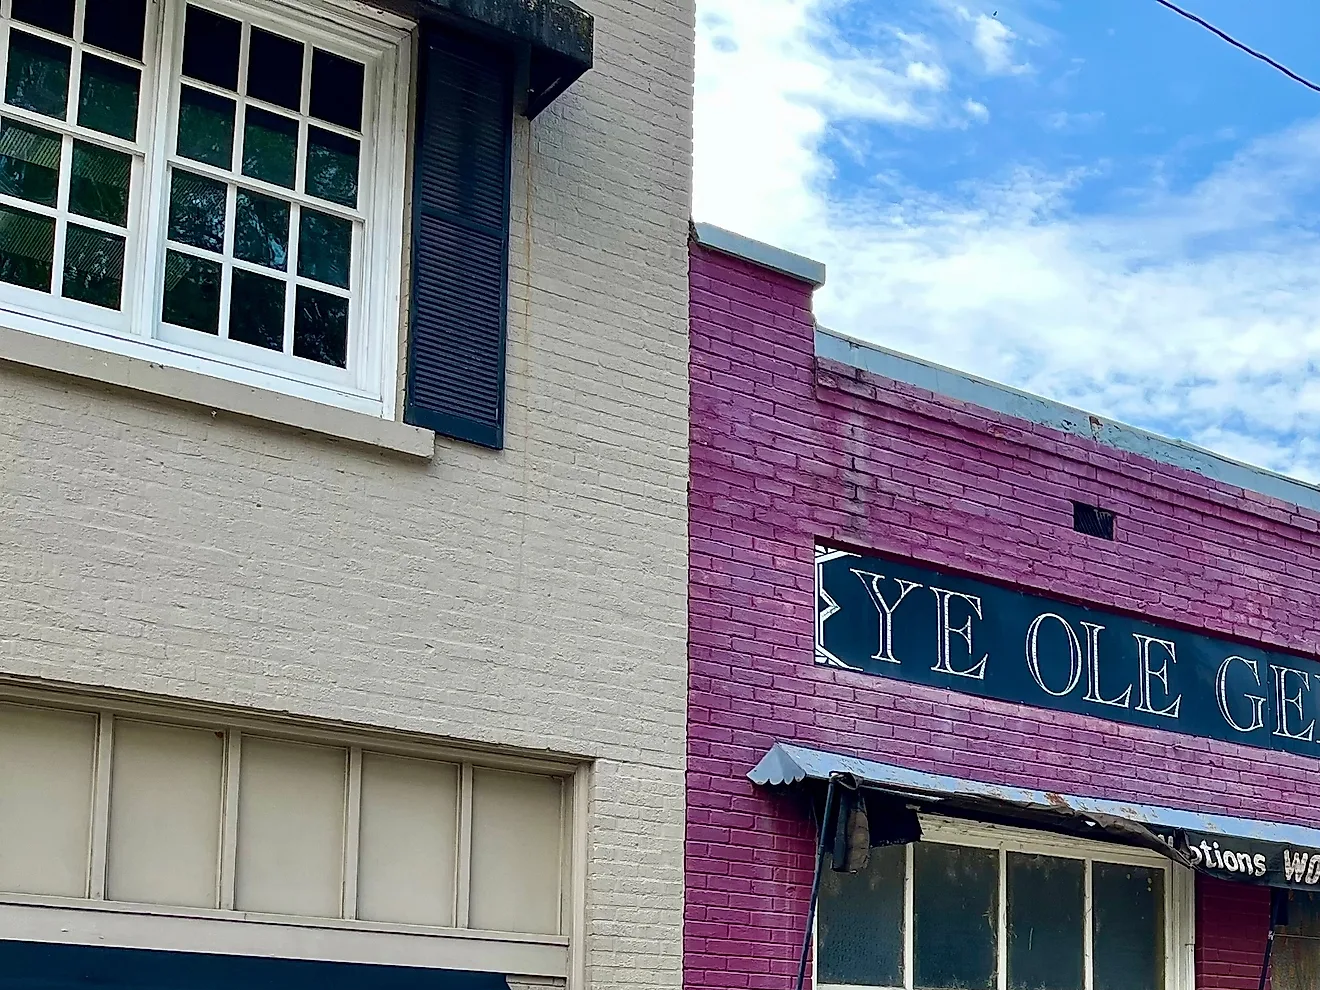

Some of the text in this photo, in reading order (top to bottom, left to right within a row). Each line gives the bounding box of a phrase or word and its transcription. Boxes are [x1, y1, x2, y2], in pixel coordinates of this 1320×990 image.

[849, 568, 989, 680] YE
[1025, 612, 1183, 719] OLE
[1158, 834, 1266, 877] otions
